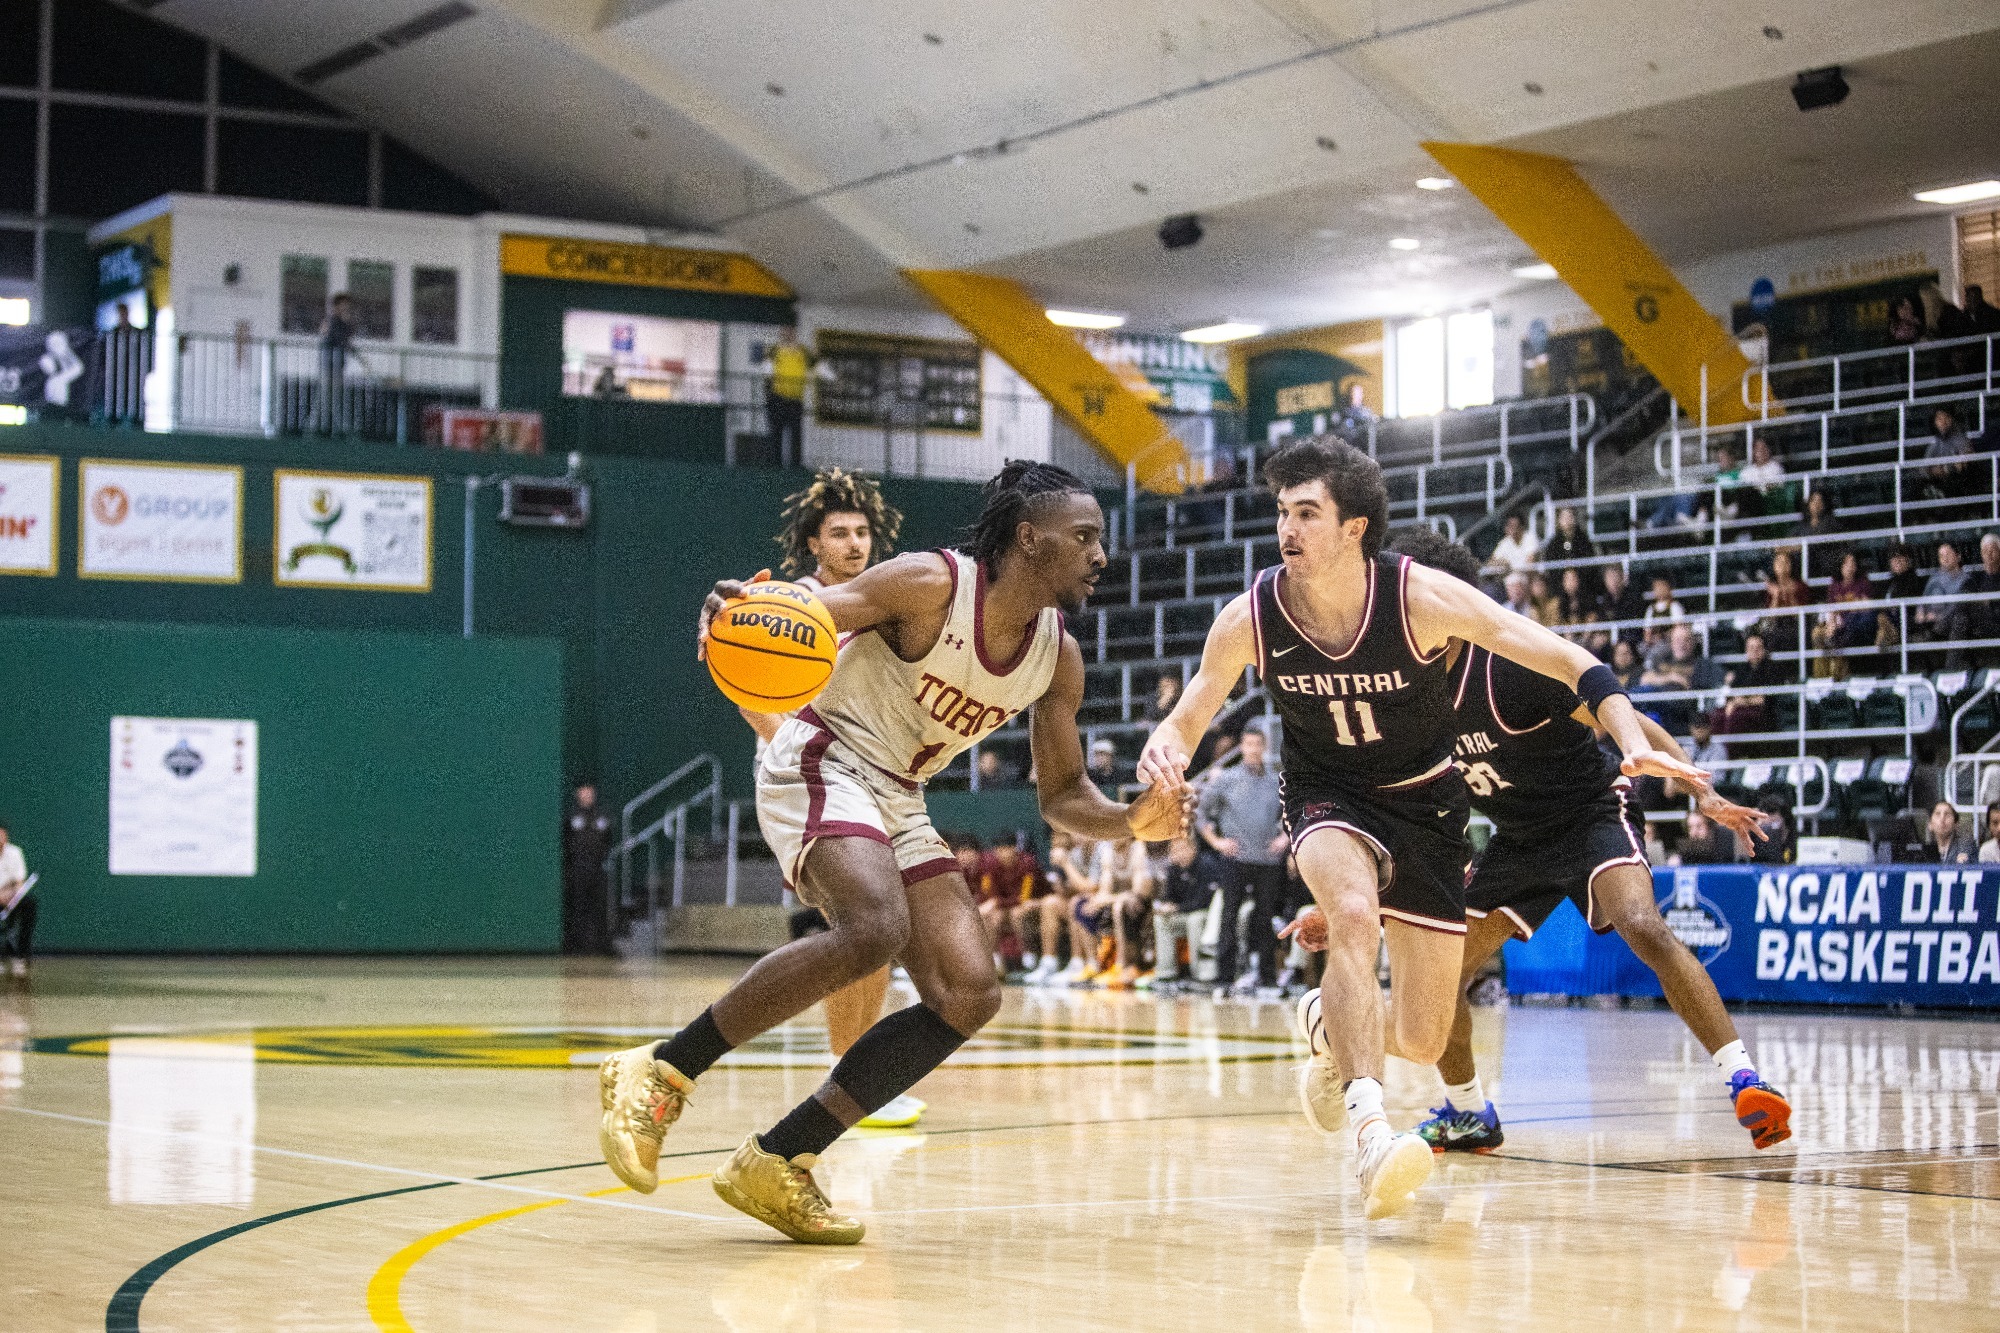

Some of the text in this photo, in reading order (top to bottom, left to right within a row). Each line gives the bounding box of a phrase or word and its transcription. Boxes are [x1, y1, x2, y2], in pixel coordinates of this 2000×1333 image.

[547, 240, 730, 284] CONCESSIONS
[134, 495, 228, 520] GROUP
[731, 612, 817, 650] Wilson
[914, 672, 1020, 737] TORO
[1277, 670, 1410, 696] CENTRAL
[1328, 700, 1383, 746] 11
[1901, 870, 1984, 924] DII
[1756, 928, 2000, 984] BASKETBA
